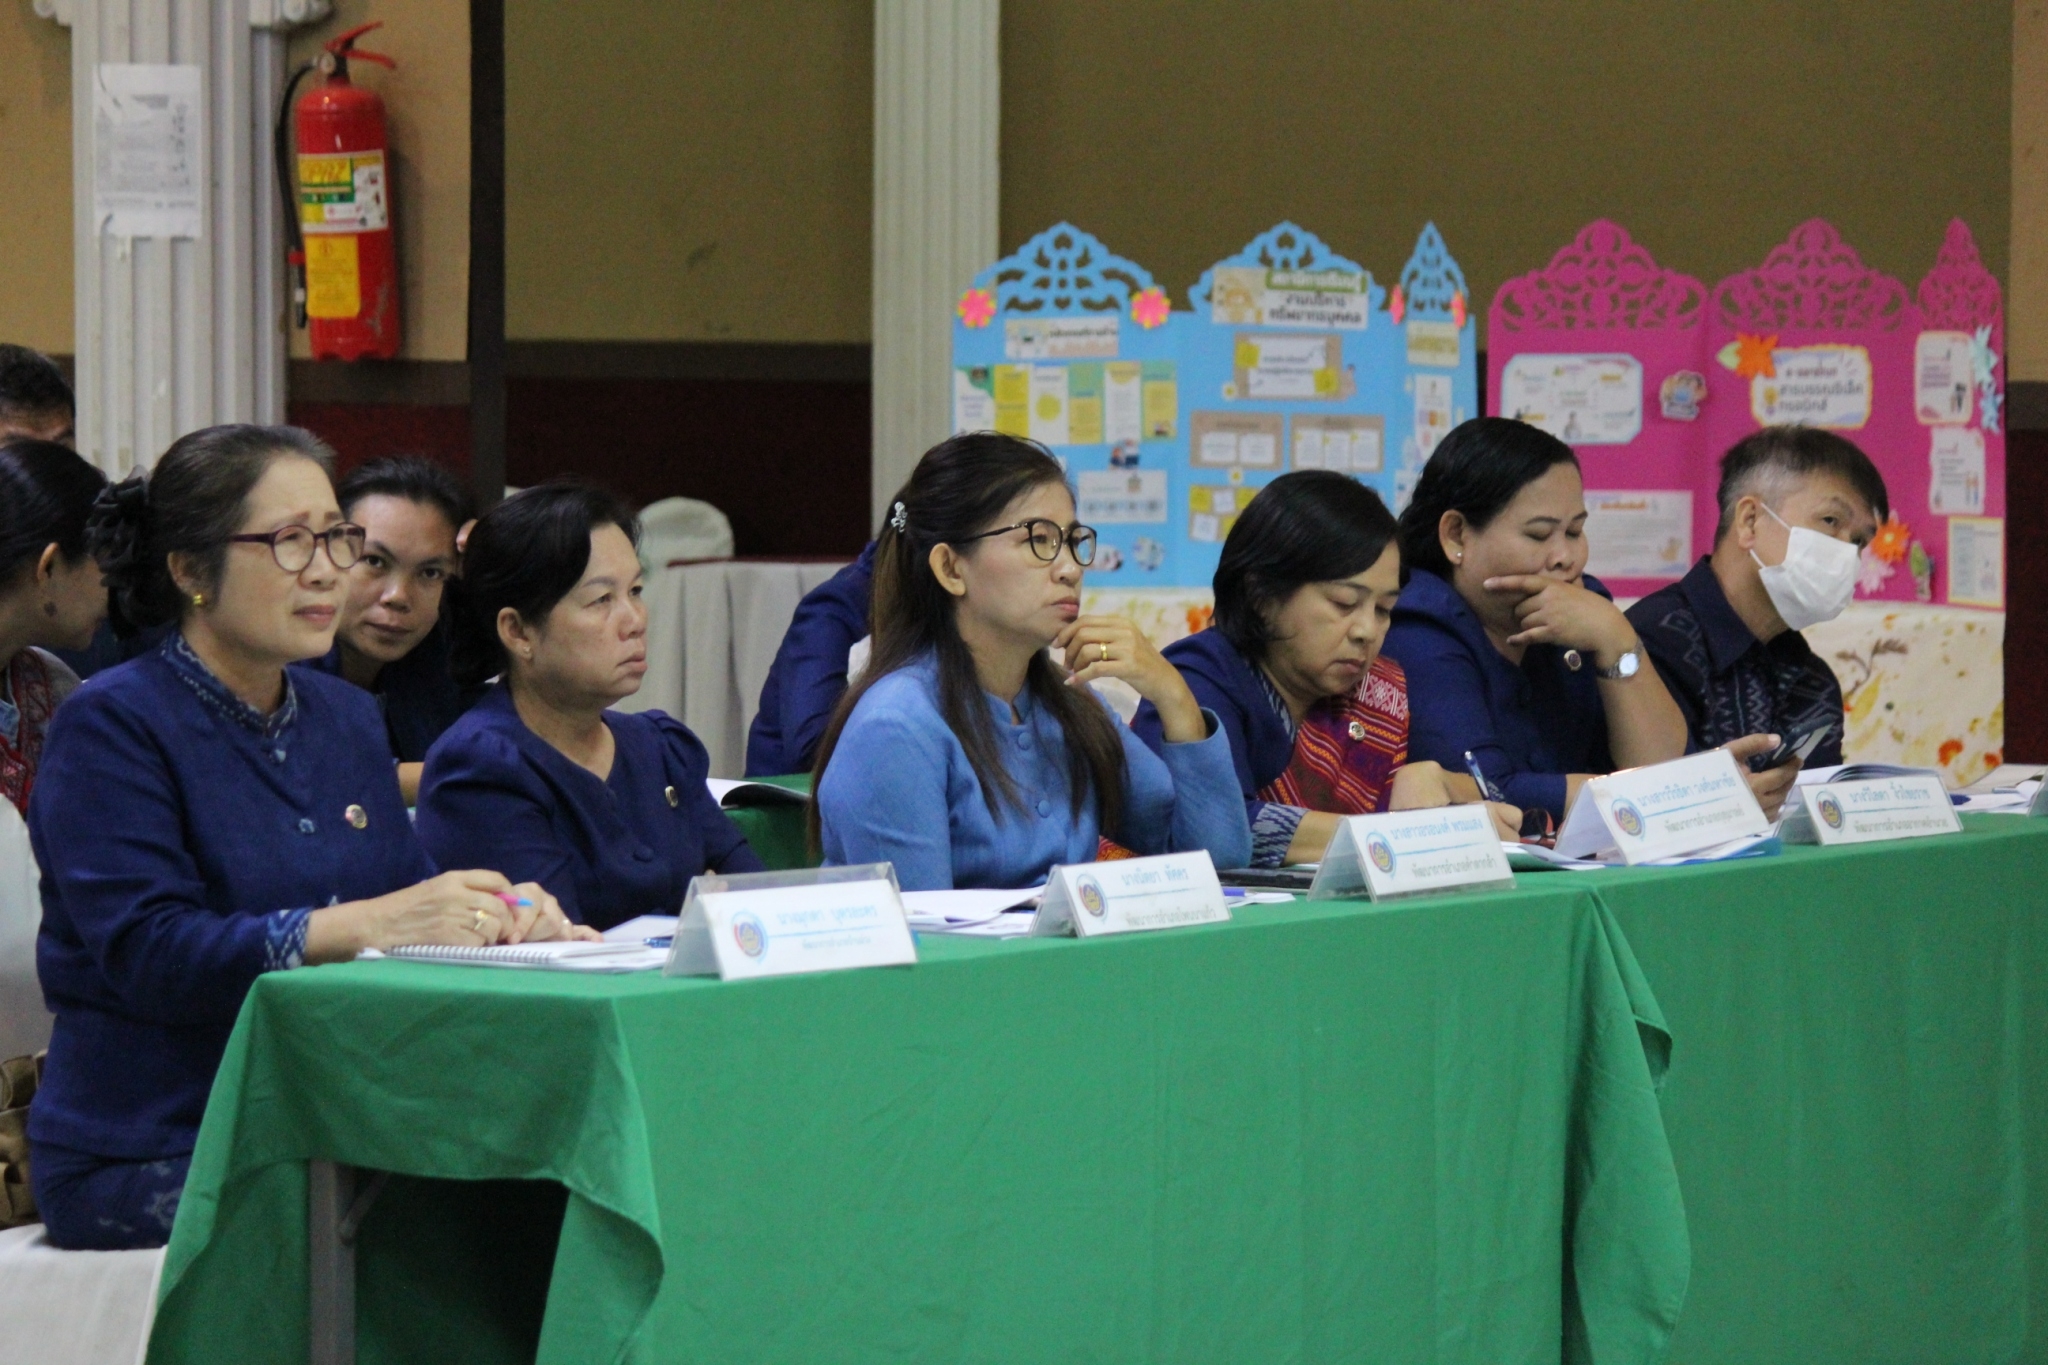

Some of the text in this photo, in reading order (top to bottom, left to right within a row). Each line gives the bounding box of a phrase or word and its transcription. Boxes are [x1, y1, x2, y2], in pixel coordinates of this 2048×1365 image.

[1269, 307, 1363, 326] ทรัพยากรบุคคล
